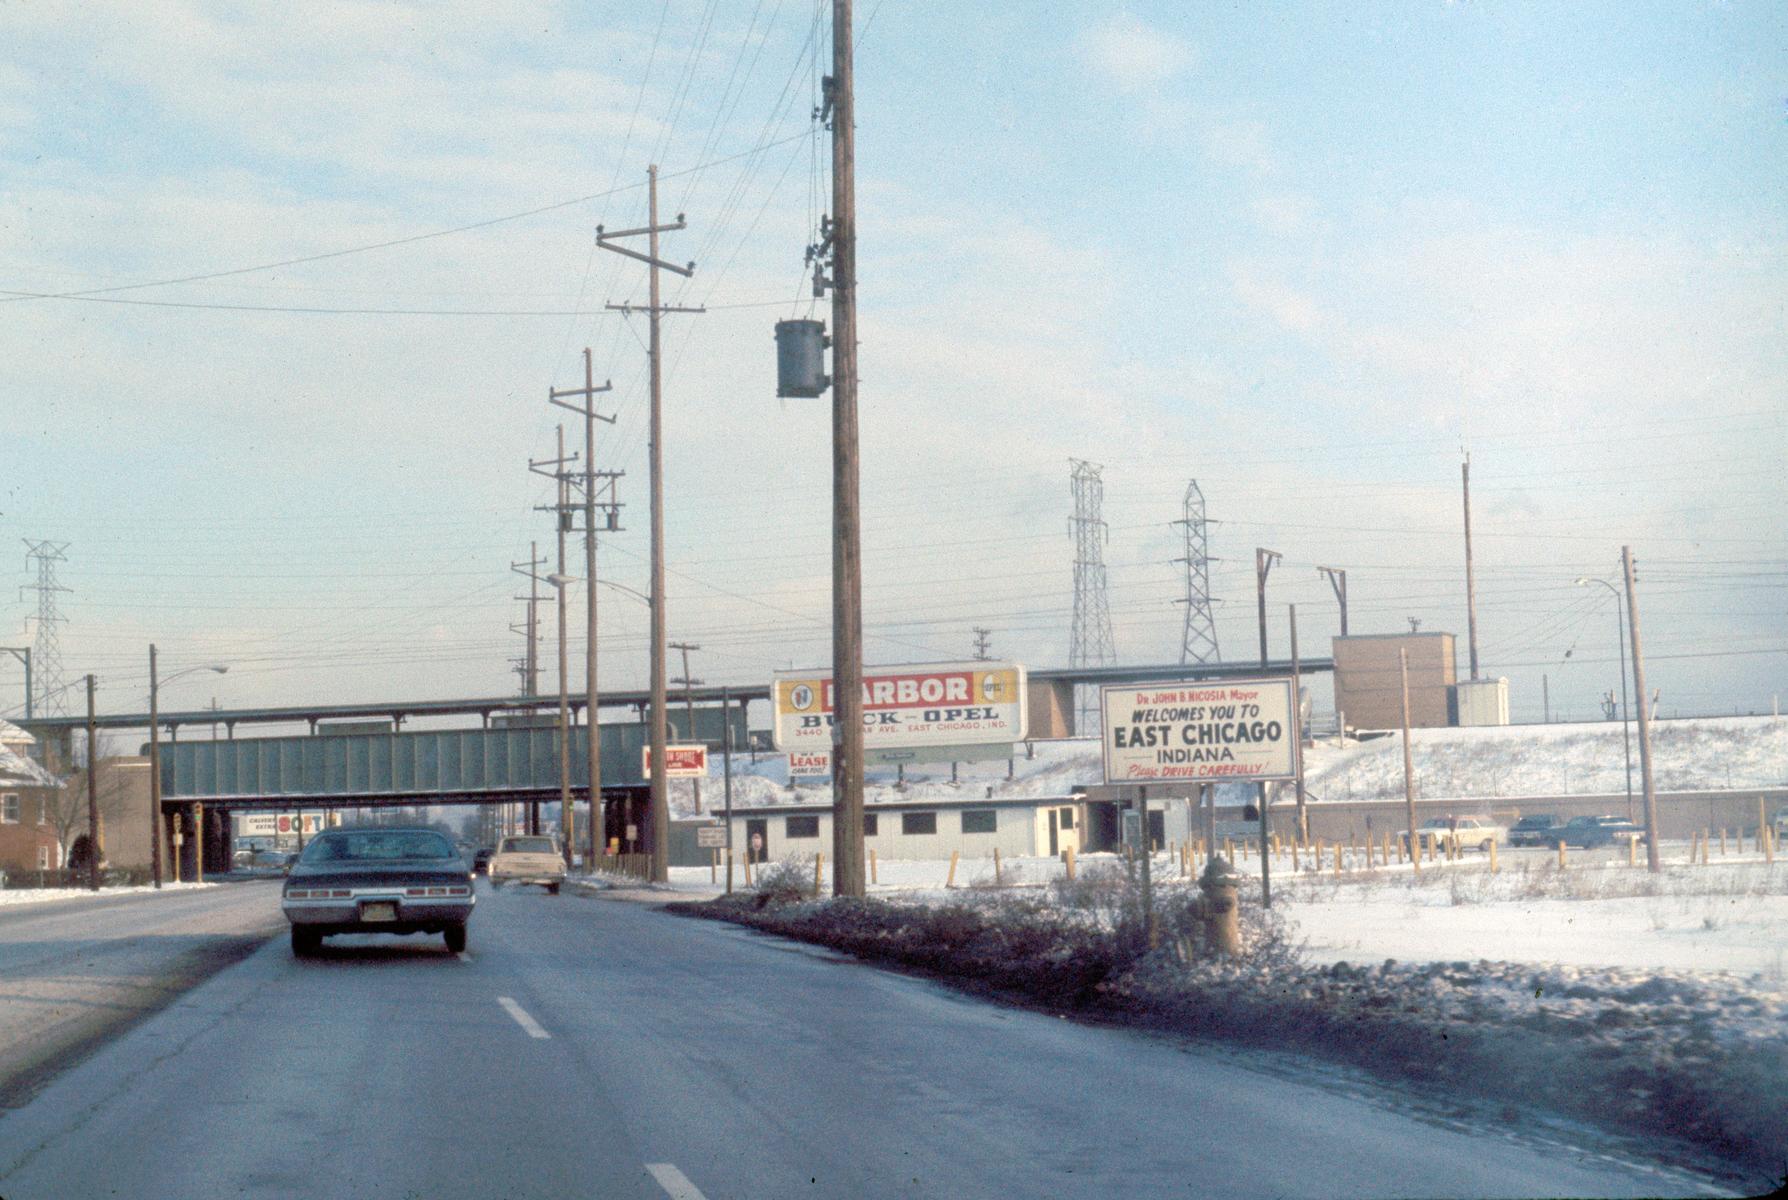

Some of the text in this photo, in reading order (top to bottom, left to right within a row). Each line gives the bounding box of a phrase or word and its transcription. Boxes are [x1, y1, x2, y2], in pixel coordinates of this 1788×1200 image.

[1152, 691, 1177, 703] JOHN
[1188, 689, 1227, 701] NICOSIA
[1230, 688, 1259, 701] Mayor
[801, 707, 999, 728] BCK OPEL
[1131, 703, 1260, 723] WELCOMES YOU TO
[795, 728, 822, 737] 3440
[908, 724, 931, 732] EAST
[1114, 721, 1282, 748] EAST CHICAGO
[790, 752, 828, 767] LEASE
[1157, 747, 1235, 764] INDIANA
[1161, 766, 1195, 777] DRIVE
[279, 816, 322, 832] SOFT
